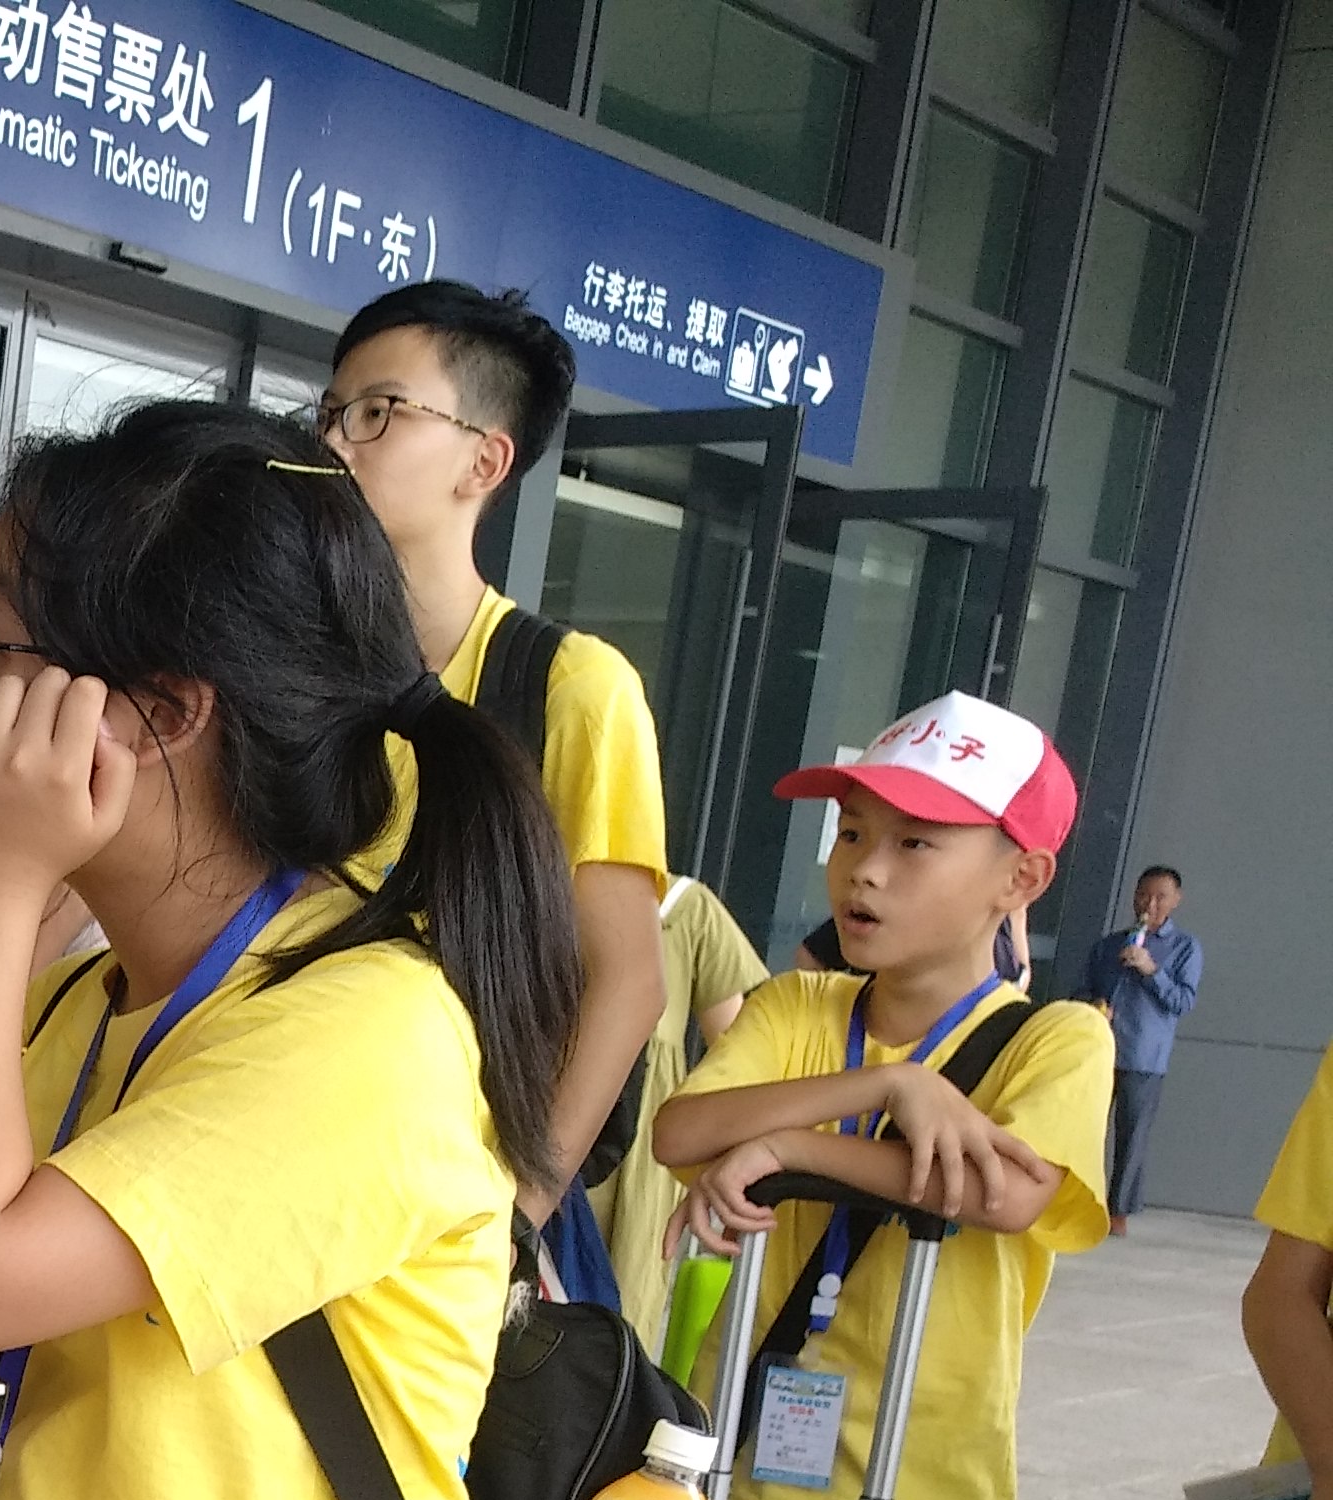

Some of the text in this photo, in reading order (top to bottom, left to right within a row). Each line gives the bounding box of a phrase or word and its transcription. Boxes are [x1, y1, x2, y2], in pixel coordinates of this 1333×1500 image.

[89, 126, 210, 224] Ticketing
[236, 77, 274, 224] 1
[564, 304, 721, 379] Baggage Check in and Claim
